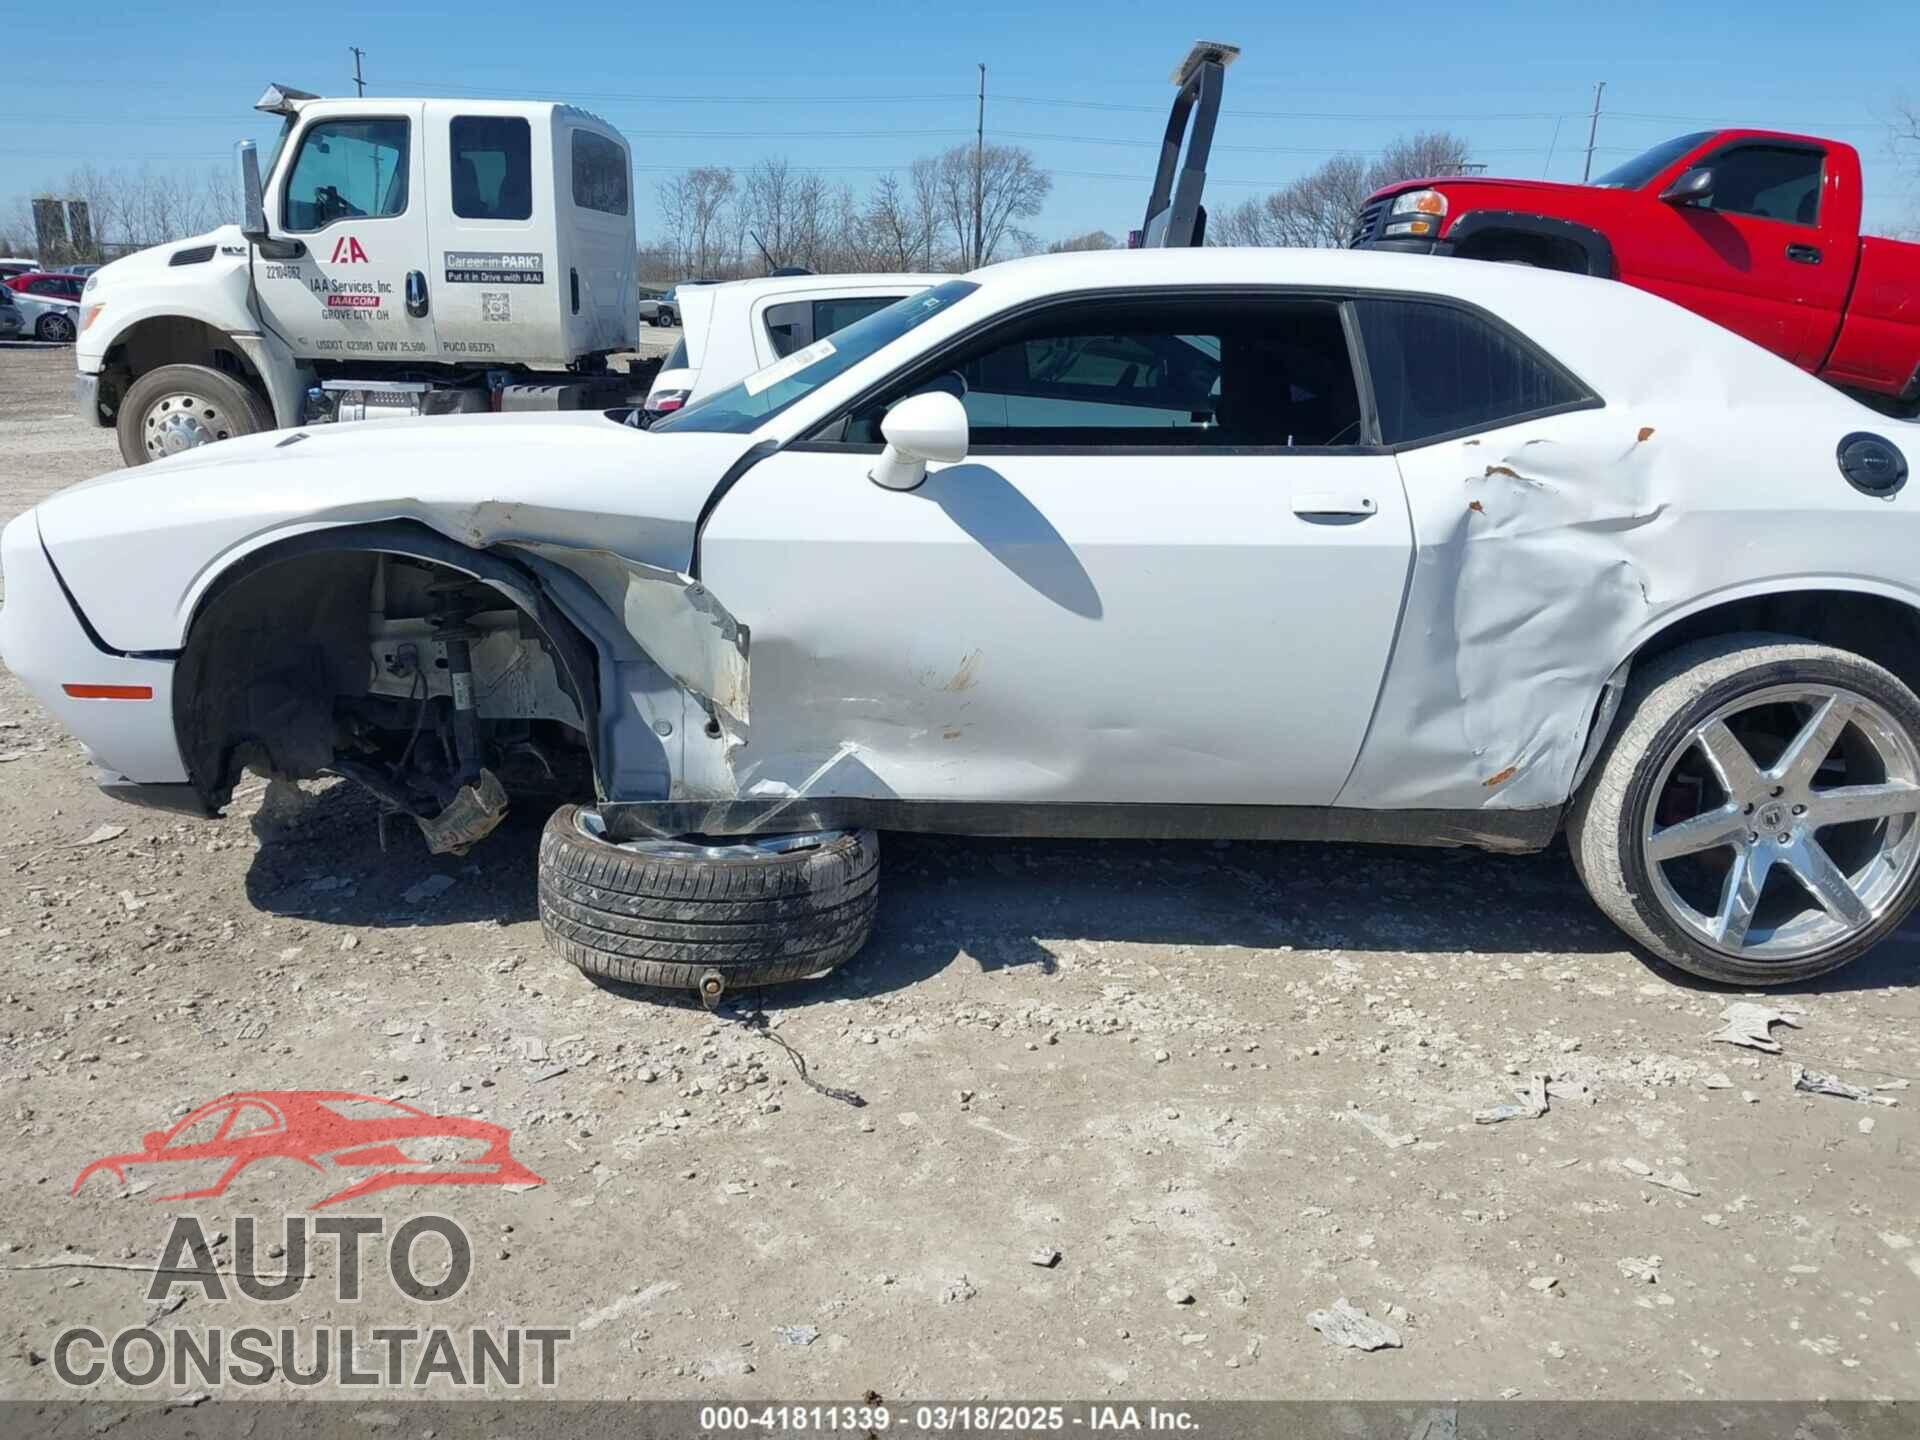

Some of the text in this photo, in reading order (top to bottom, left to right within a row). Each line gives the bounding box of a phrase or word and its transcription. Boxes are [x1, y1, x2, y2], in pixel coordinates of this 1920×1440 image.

[502, 256, 540, 268] PARK?
[448, 272, 462, 281] Put
[481, 273, 501, 282] Drive
[503, 274, 521, 282] with
[310, 280, 329, 292] IAA
[378, 281, 395, 293] Inc.
[322, 309, 352, 320] GROVE
[376, 310, 390, 320] OH
[316, 340, 343, 351] USDOT
[376, 341, 398, 352] GVW
[443, 341, 466, 352] PUCO
